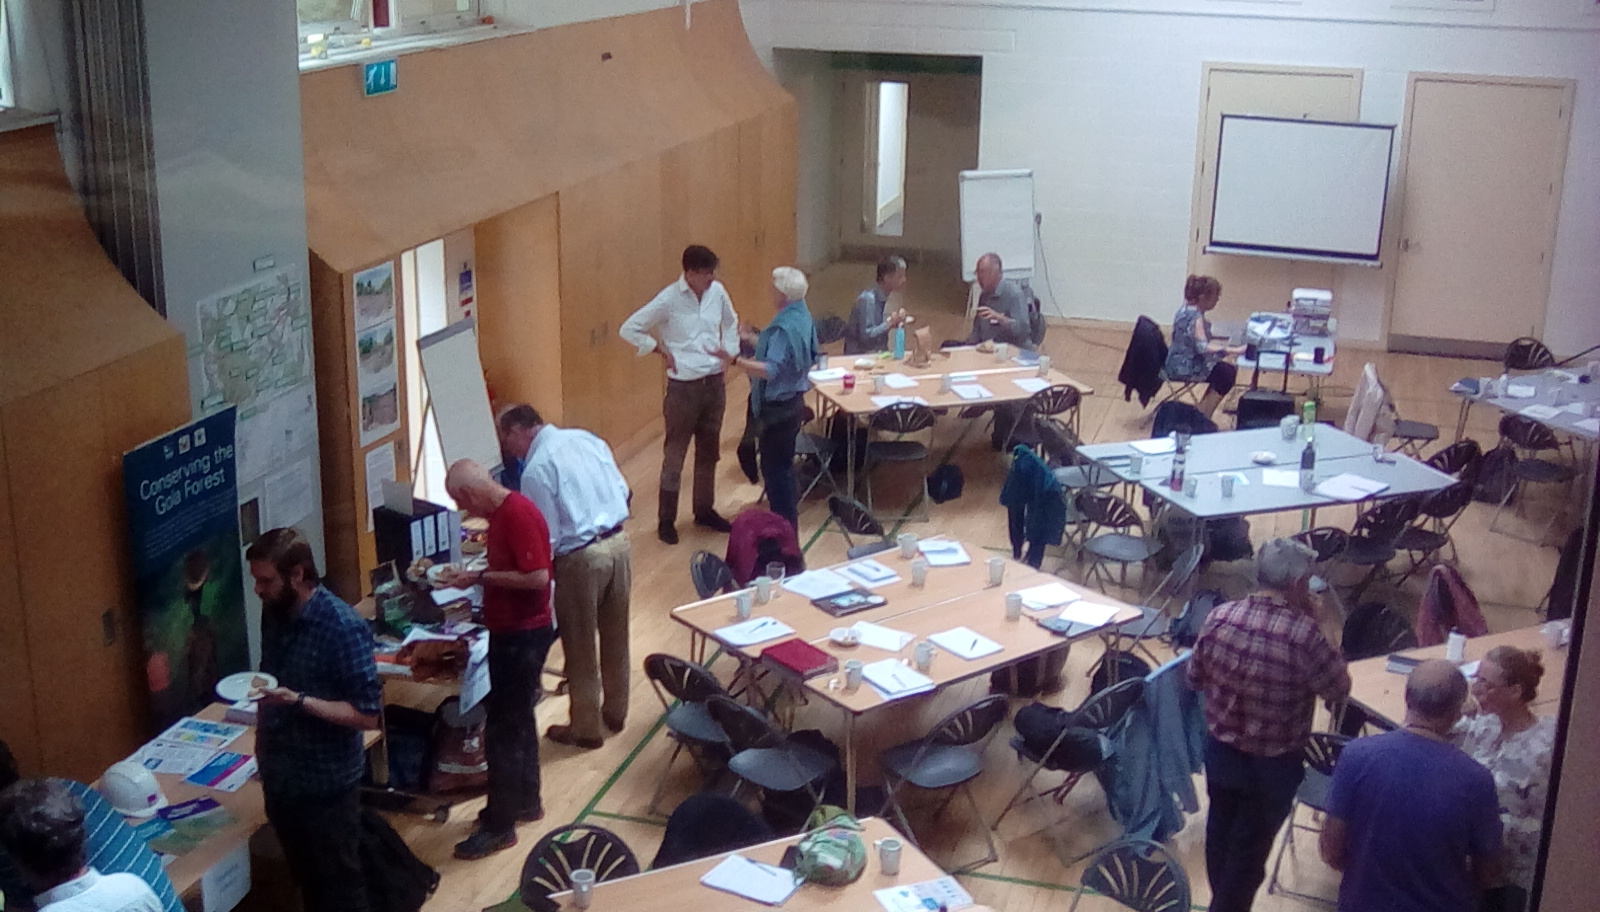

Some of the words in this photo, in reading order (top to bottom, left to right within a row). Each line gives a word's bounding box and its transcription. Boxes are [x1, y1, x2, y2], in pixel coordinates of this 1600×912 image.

[140, 455, 210, 500] Conserving
[214, 444, 233, 464] the
[184, 469, 225, 498] Forest
